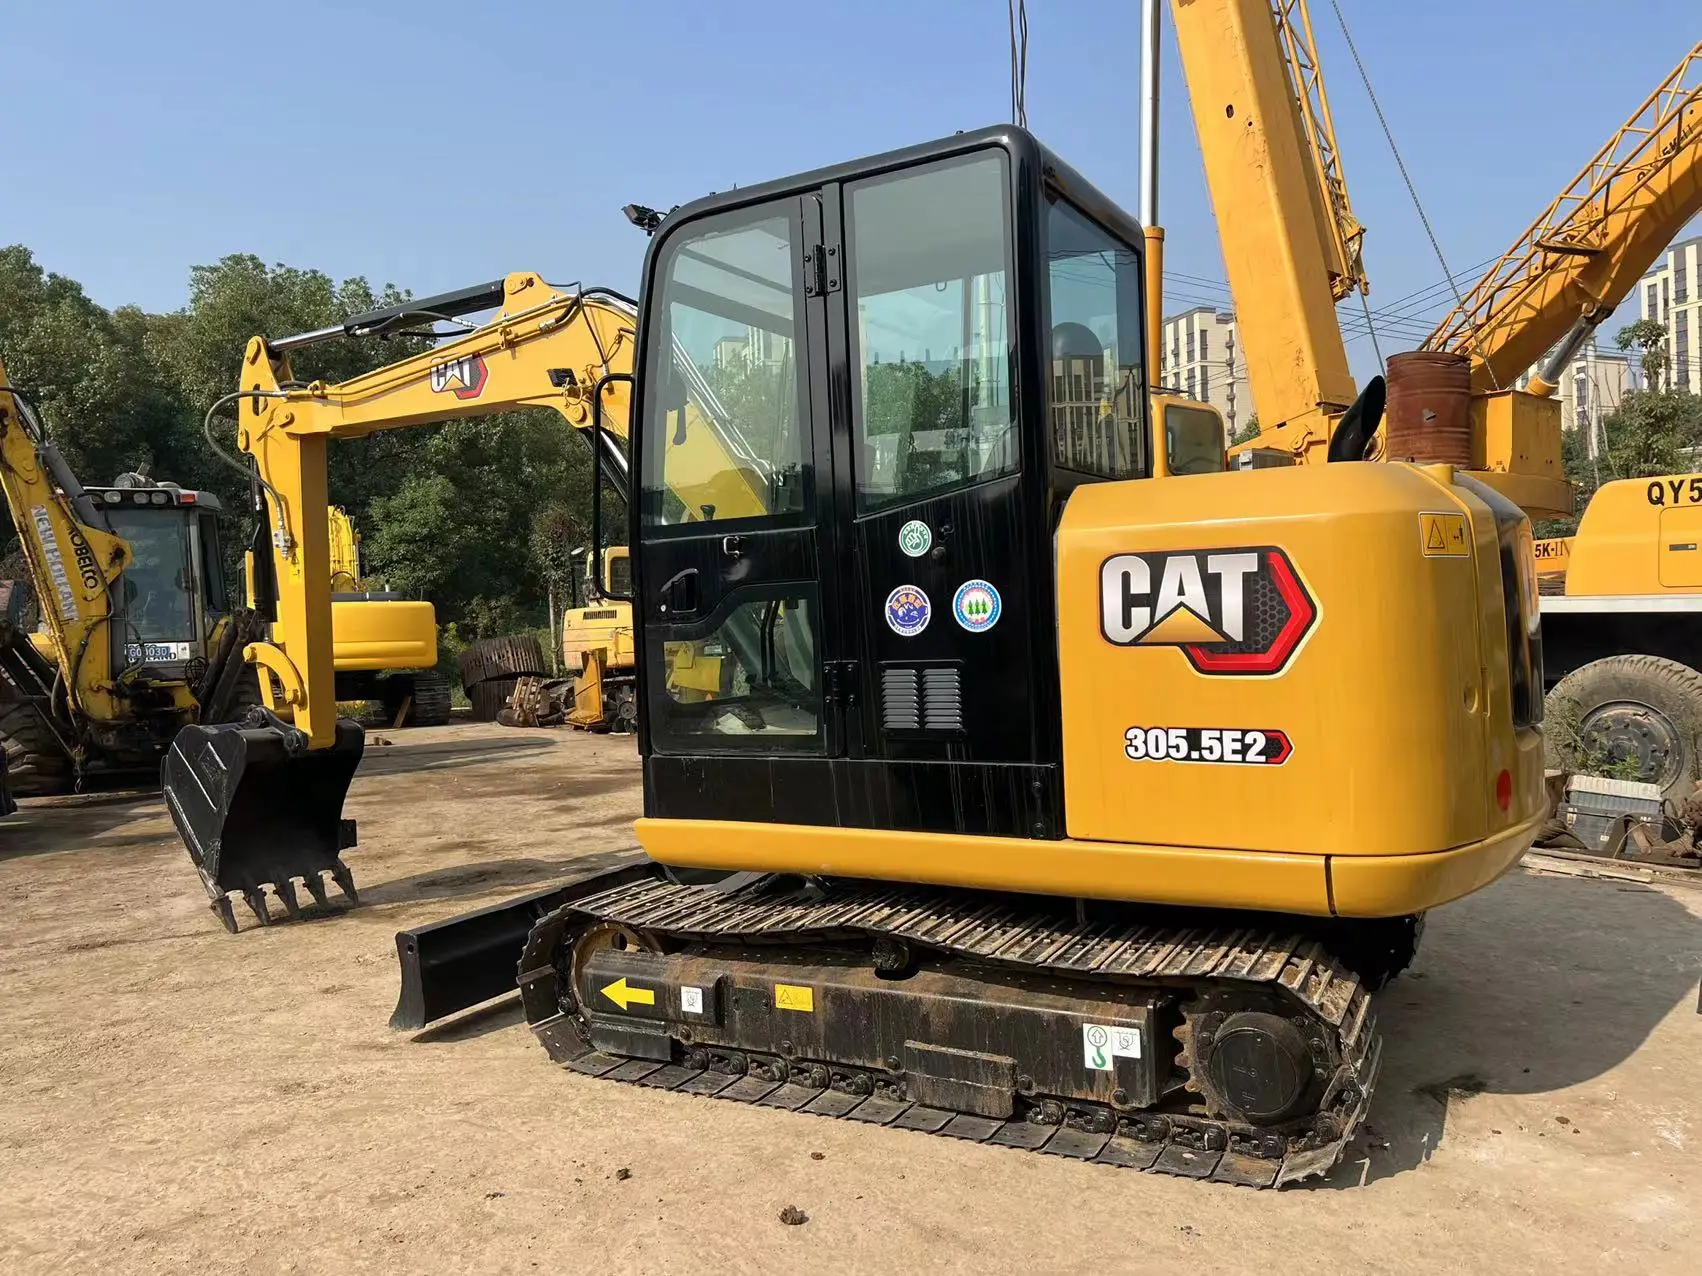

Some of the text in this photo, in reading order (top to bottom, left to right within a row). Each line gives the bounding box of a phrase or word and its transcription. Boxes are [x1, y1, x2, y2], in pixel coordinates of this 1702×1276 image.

[431, 357, 471, 393] CAT
[1648, 478, 1702, 506] QY5
[1102, 553, 1258, 643] CAT
[1125, 728, 1267, 762] 305.5E2
